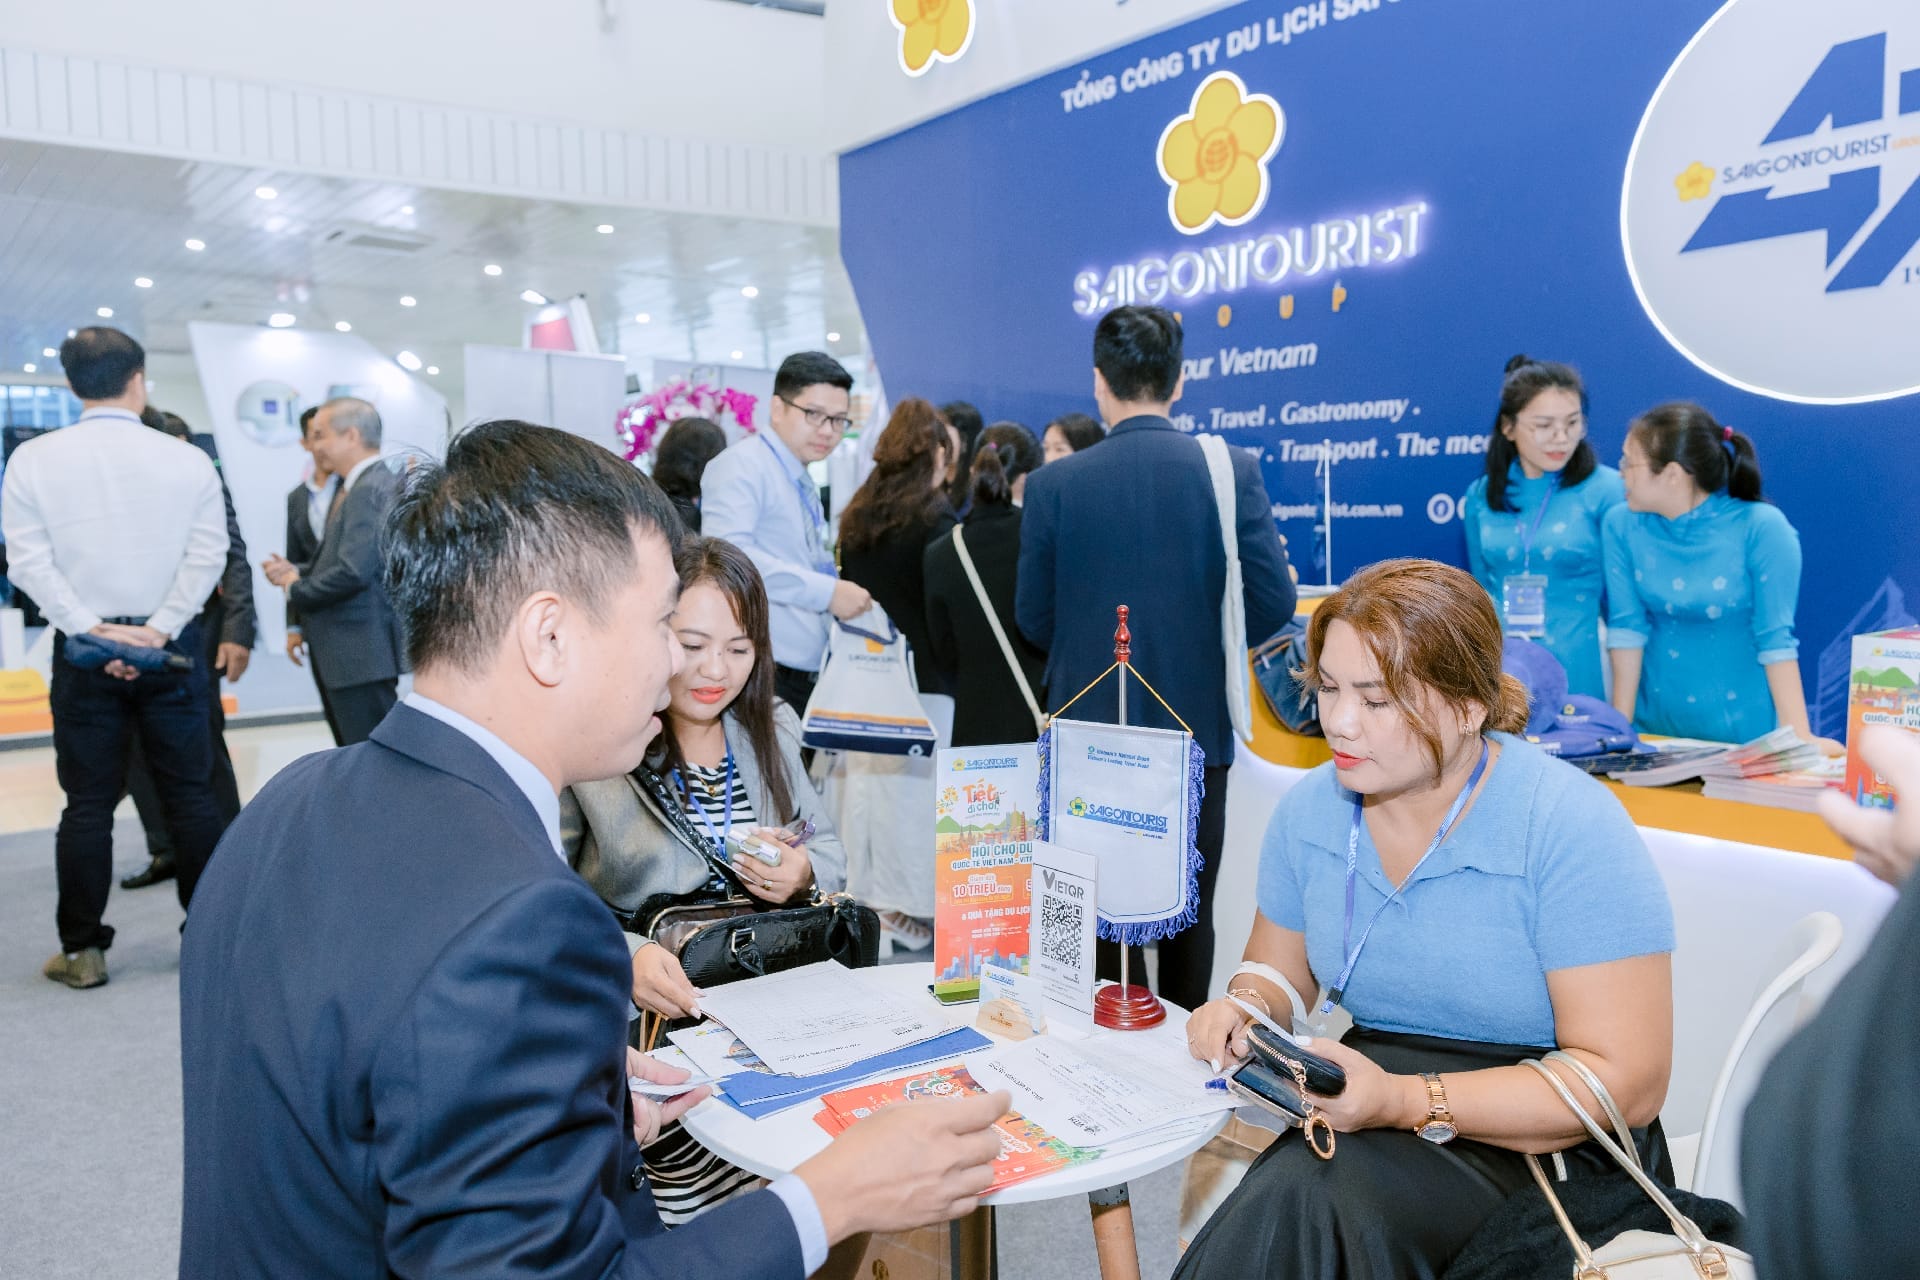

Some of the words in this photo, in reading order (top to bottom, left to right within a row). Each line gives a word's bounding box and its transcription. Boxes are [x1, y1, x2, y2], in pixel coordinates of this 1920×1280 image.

[1061, 69, 1117, 112] TỔNG
[1121, 52, 1184, 93] CÔNG
[1188, 37, 1220, 70] TY
[1226, 22, 1261, 58] DU
[1266, 0, 1327, 45] LỊCH
[1723, 134, 1891, 184] SAIGONTOURIST
[1072, 202, 1427, 315] SAIGONTOURIST
[1220, 343, 1318, 376] Vietnam
[1209, 404, 1266, 429] Travel
[1281, 398, 1410, 425] Gastronomy
[1396, 432, 1440, 457] The
[1089, 804, 1168, 828] SAIGONTOURIST
[954, 885, 966, 897] 10
